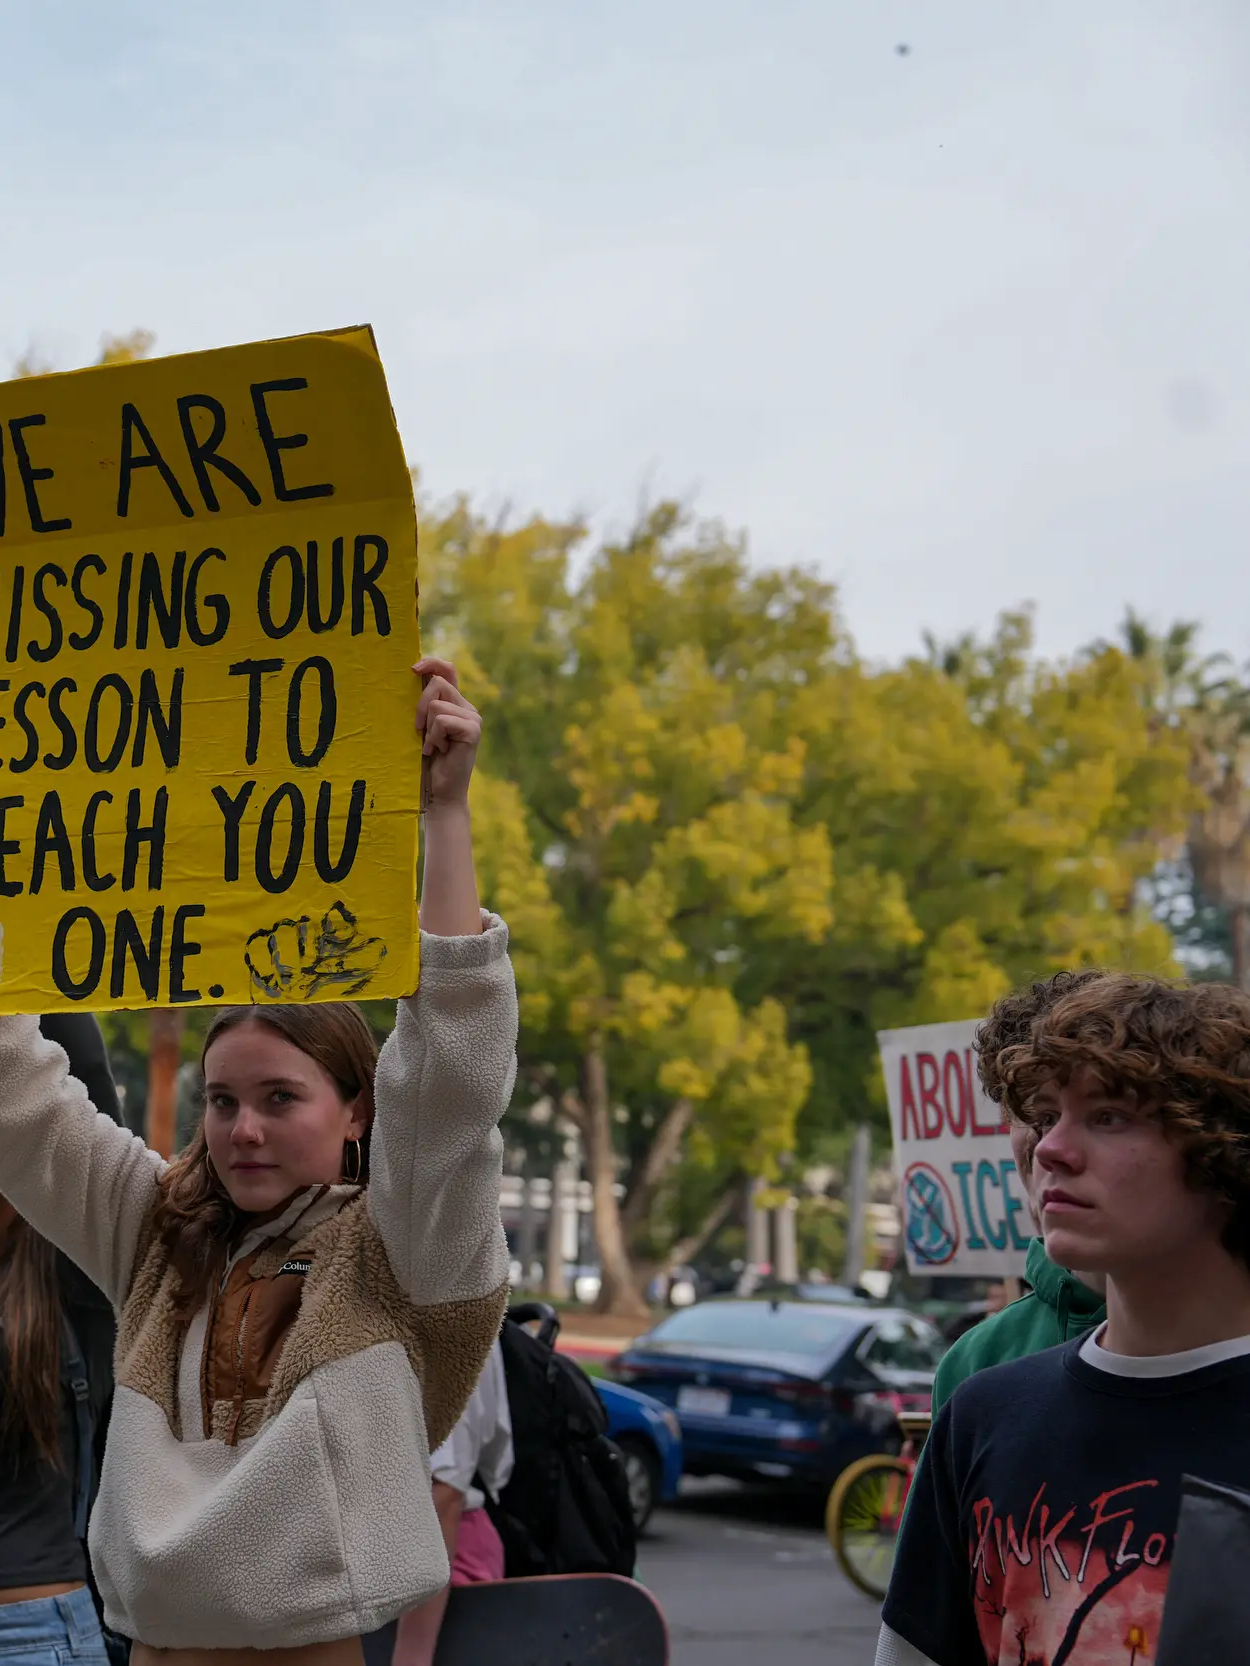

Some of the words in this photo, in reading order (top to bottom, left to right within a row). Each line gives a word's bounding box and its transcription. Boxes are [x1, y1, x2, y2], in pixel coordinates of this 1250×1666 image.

[116, 376, 337, 519] ARE
[257, 533, 392, 641] OUR
[228, 655, 338, 769] TO
[210, 779, 367, 895] YOU
[51, 903, 226, 1004] ONE.
[900, 1048, 1010, 1139] ABOL
[951, 1158, 1033, 1251] ICE
[972, 1481, 1078, 1598] PINK
